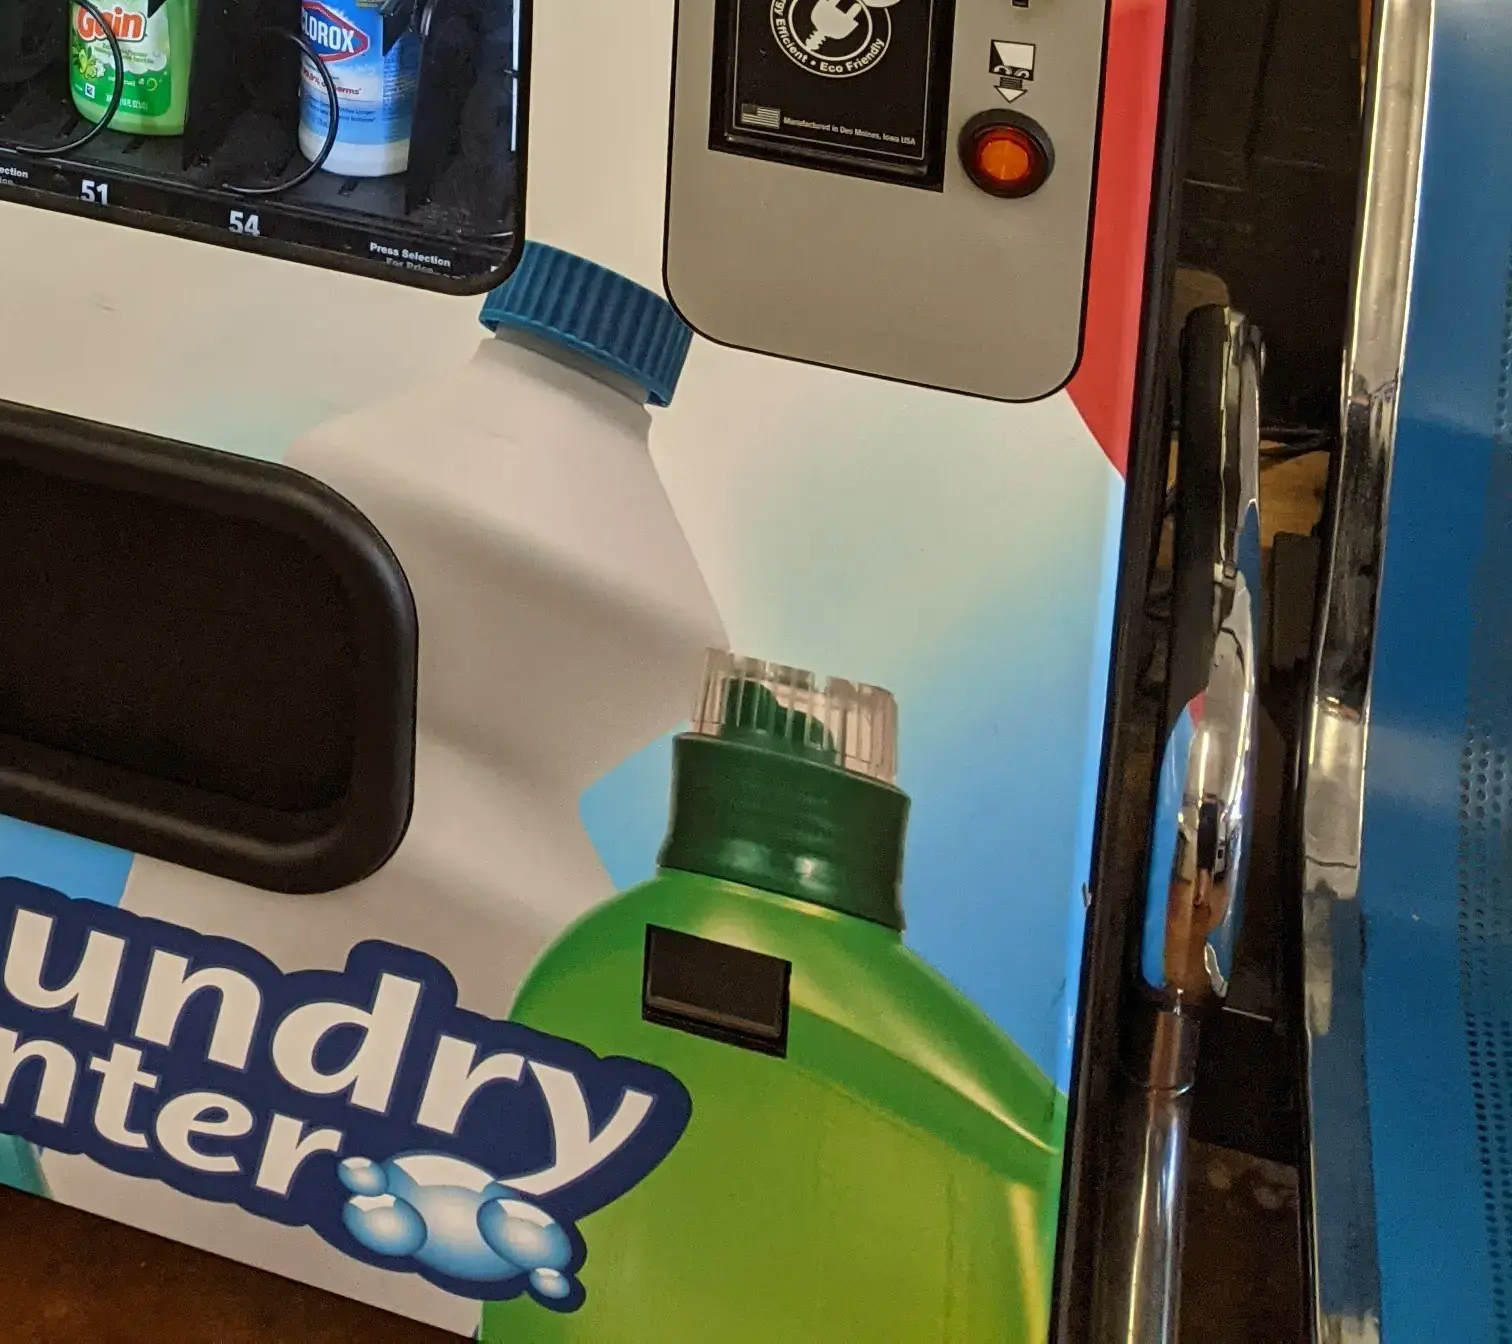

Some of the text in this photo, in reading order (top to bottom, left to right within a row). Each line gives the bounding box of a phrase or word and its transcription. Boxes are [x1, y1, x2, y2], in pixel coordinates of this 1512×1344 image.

[76, 5, 147, 43] Gain
[775, 18, 808, 63] Efficient
[819, 62, 844, 73] Eco
[845, 38, 886, 72] Friendly
[900, 136, 916, 146] USA
[80, 179, 109, 206] 51
[228, 210, 261, 237] 54
